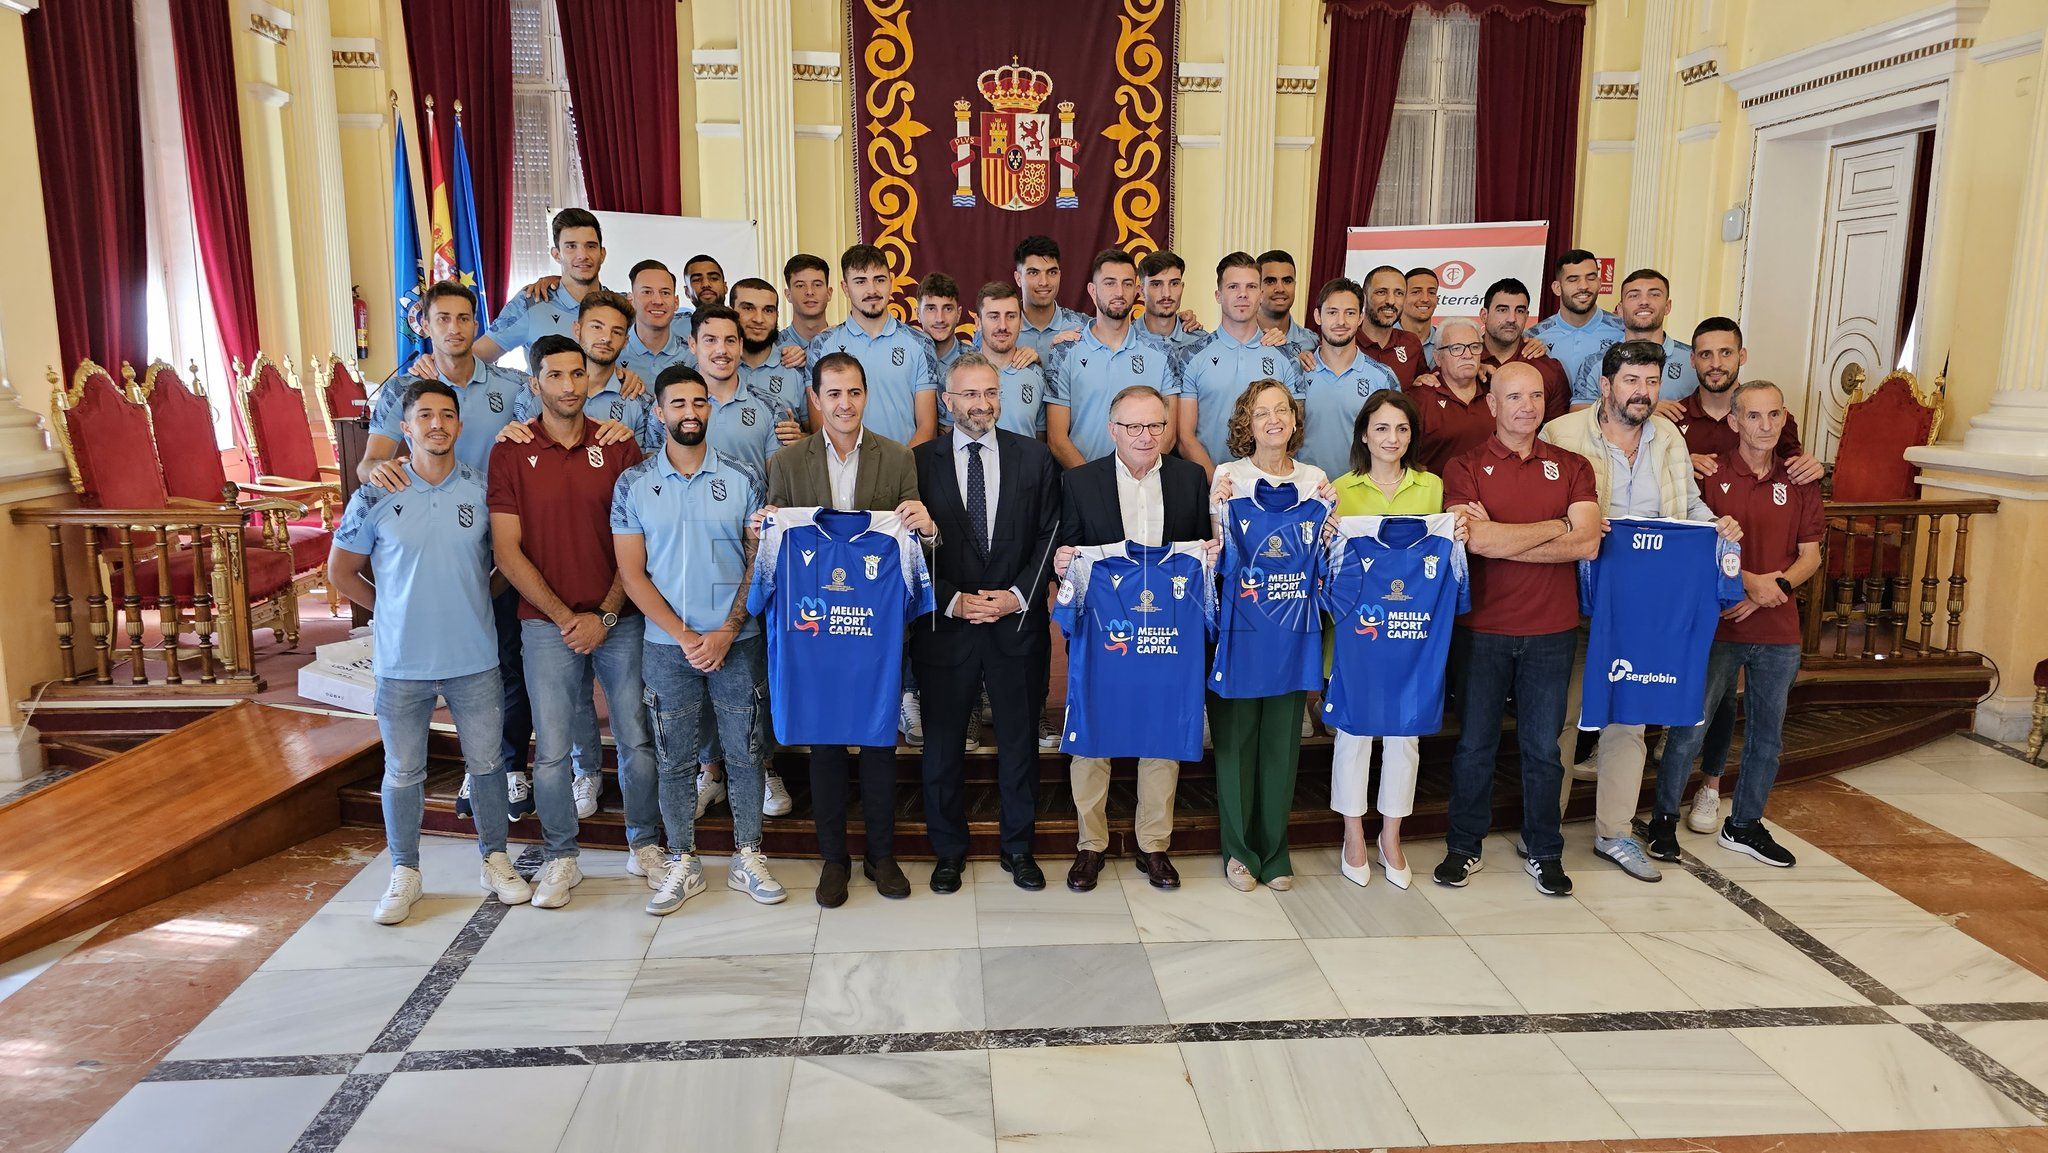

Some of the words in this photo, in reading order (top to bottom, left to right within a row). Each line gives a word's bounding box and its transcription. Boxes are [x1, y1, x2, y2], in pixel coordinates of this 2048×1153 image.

[954, 136, 975, 146] PLVS
[1053, 138, 1078, 149] VLTRA
[1437, 294, 1485, 306] iterrán
[1632, 533, 1664, 551] SITO
[1267, 571, 1307, 582] MELILLA
[1267, 581, 1300, 591] SPORT
[1267, 590, 1308, 600] CAPITAL
[830, 605, 874, 617] MELILLA
[1387, 611, 1431, 621] MELILLA
[829, 615, 865, 626] SPORT
[1387, 620, 1423, 630] SPORT
[828, 625, 873, 637] CAPITAL
[1137, 626, 1179, 636] MELILLA
[1386, 629, 1428, 640] CAPITAL
[1137, 635, 1171, 645] SPORT
[1136, 645, 1178, 654] CAPITAL
[1625, 671, 1678, 685] serglobin
